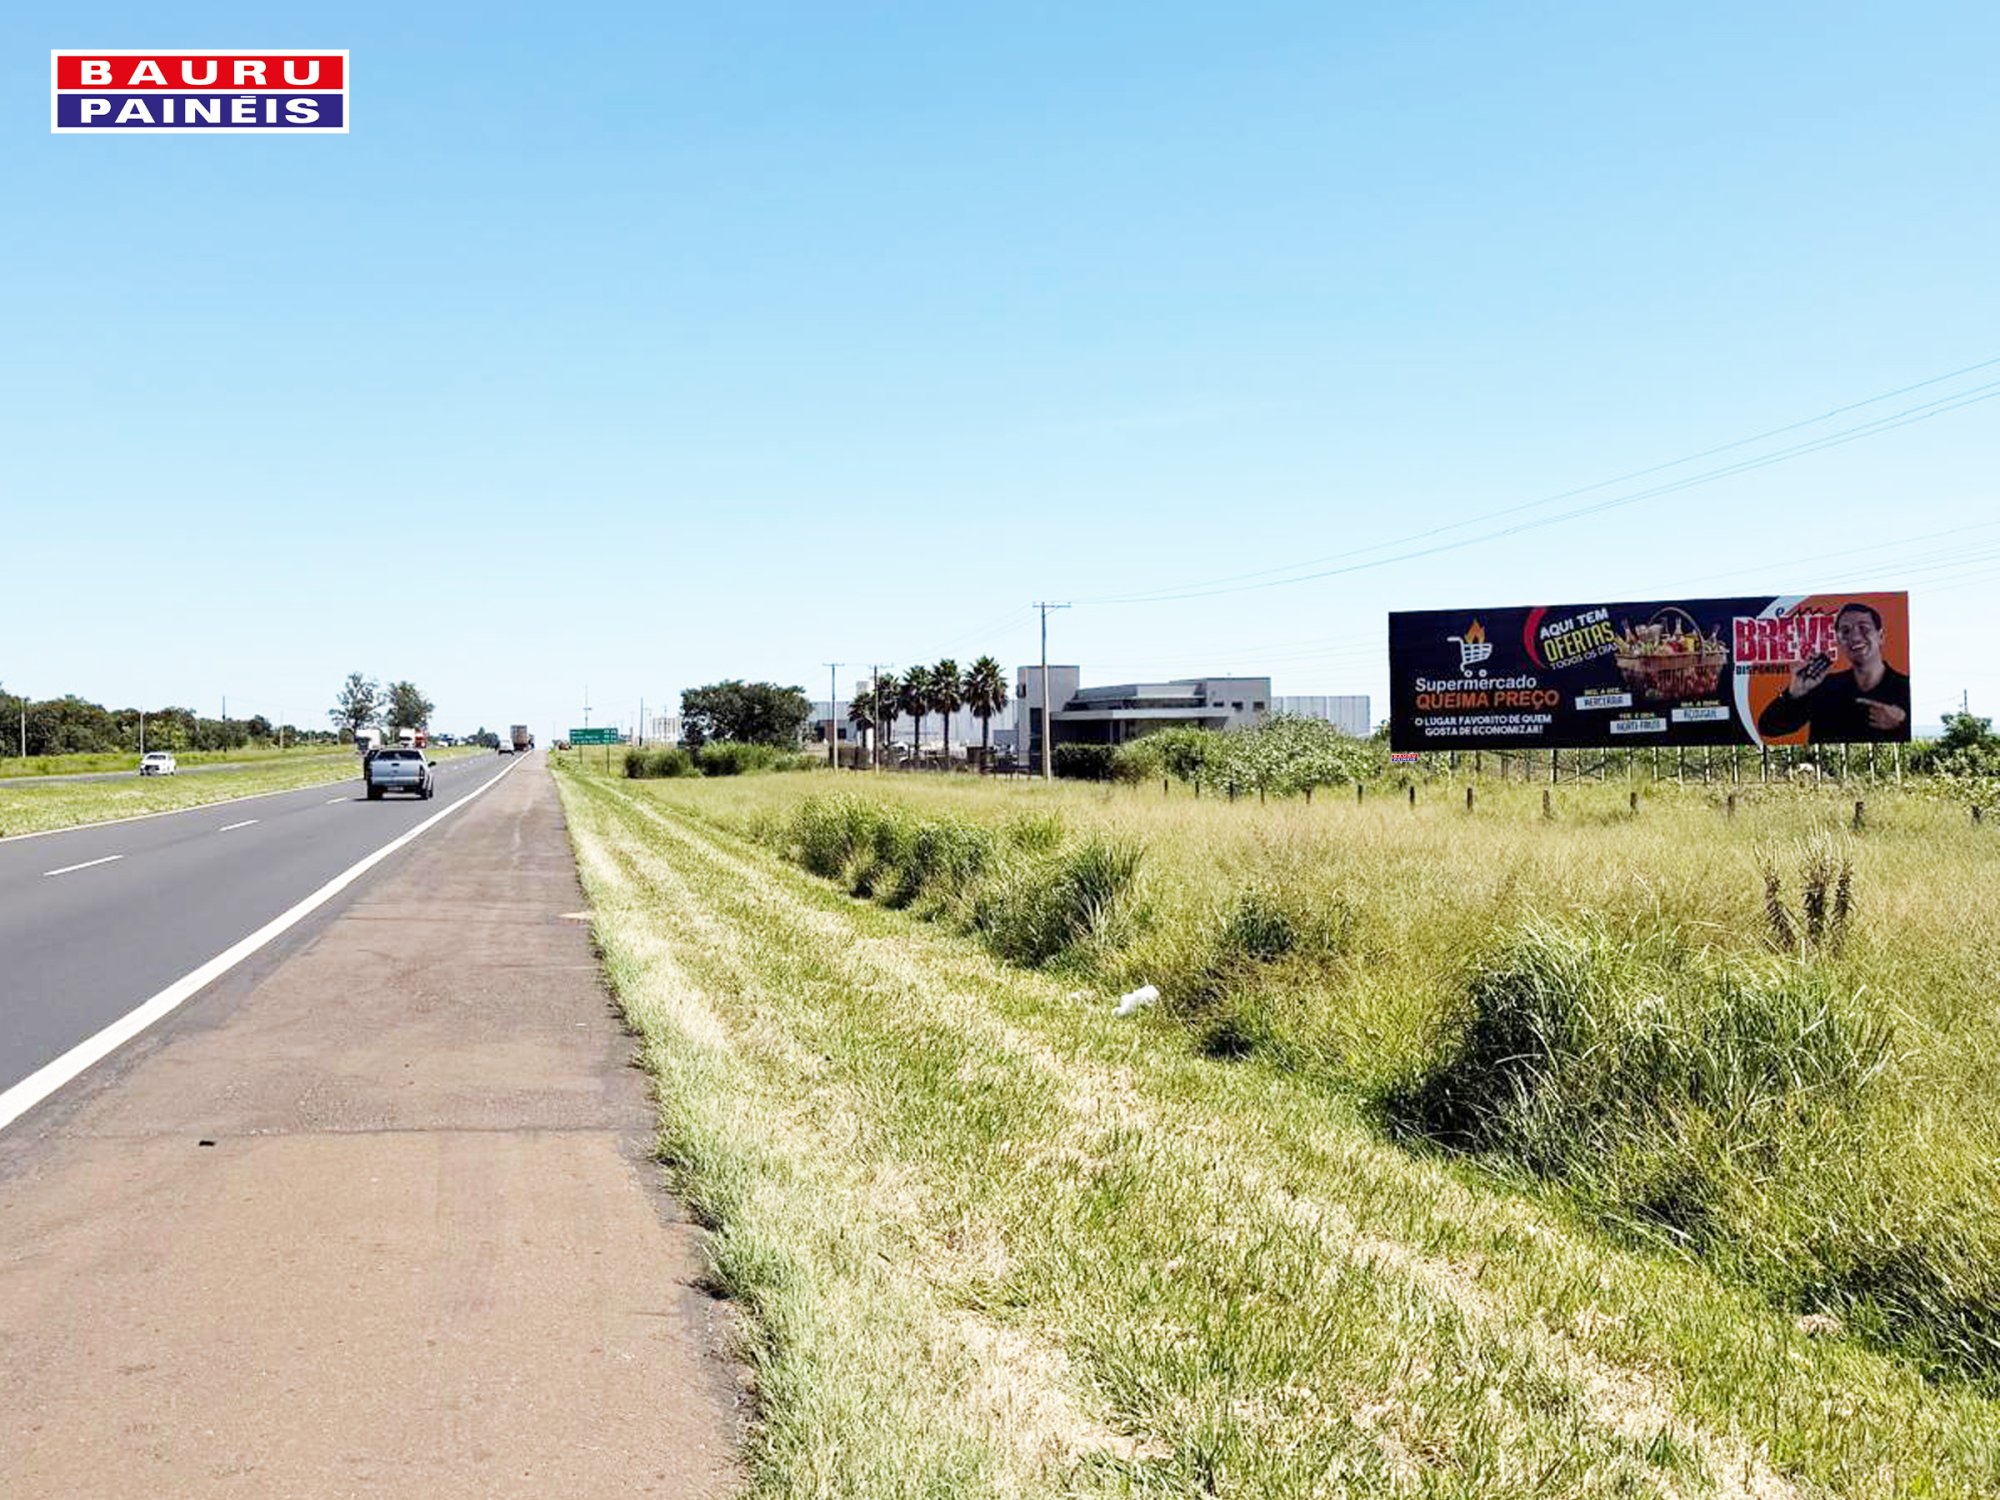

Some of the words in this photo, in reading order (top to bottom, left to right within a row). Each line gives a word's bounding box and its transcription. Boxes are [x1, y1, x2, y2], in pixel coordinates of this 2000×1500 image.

[1541, 618, 1574, 640] AQUI
[1576, 607, 1609, 626] TEM
[1544, 621, 1615, 662] OFERTAS
[1733, 614, 1838, 662] BREVE
[1415, 674, 1537, 694] Supermercado
[1416, 692, 1490, 710] QUEIMA
[1494, 690, 1560, 710] PREÇO
[1415, 717, 1423, 726] O
[1424, 716, 1457, 726] LUGAR
[1459, 714, 1507, 725] FAVORITO
[1509, 714, 1520, 724] DE
[1521, 714, 1552, 724] QUEM
[1425, 726, 1458, 736] GOSTA
[1459, 726, 1471, 735] DE
[1472, 724, 1543, 735] ECONOMIZAR!
